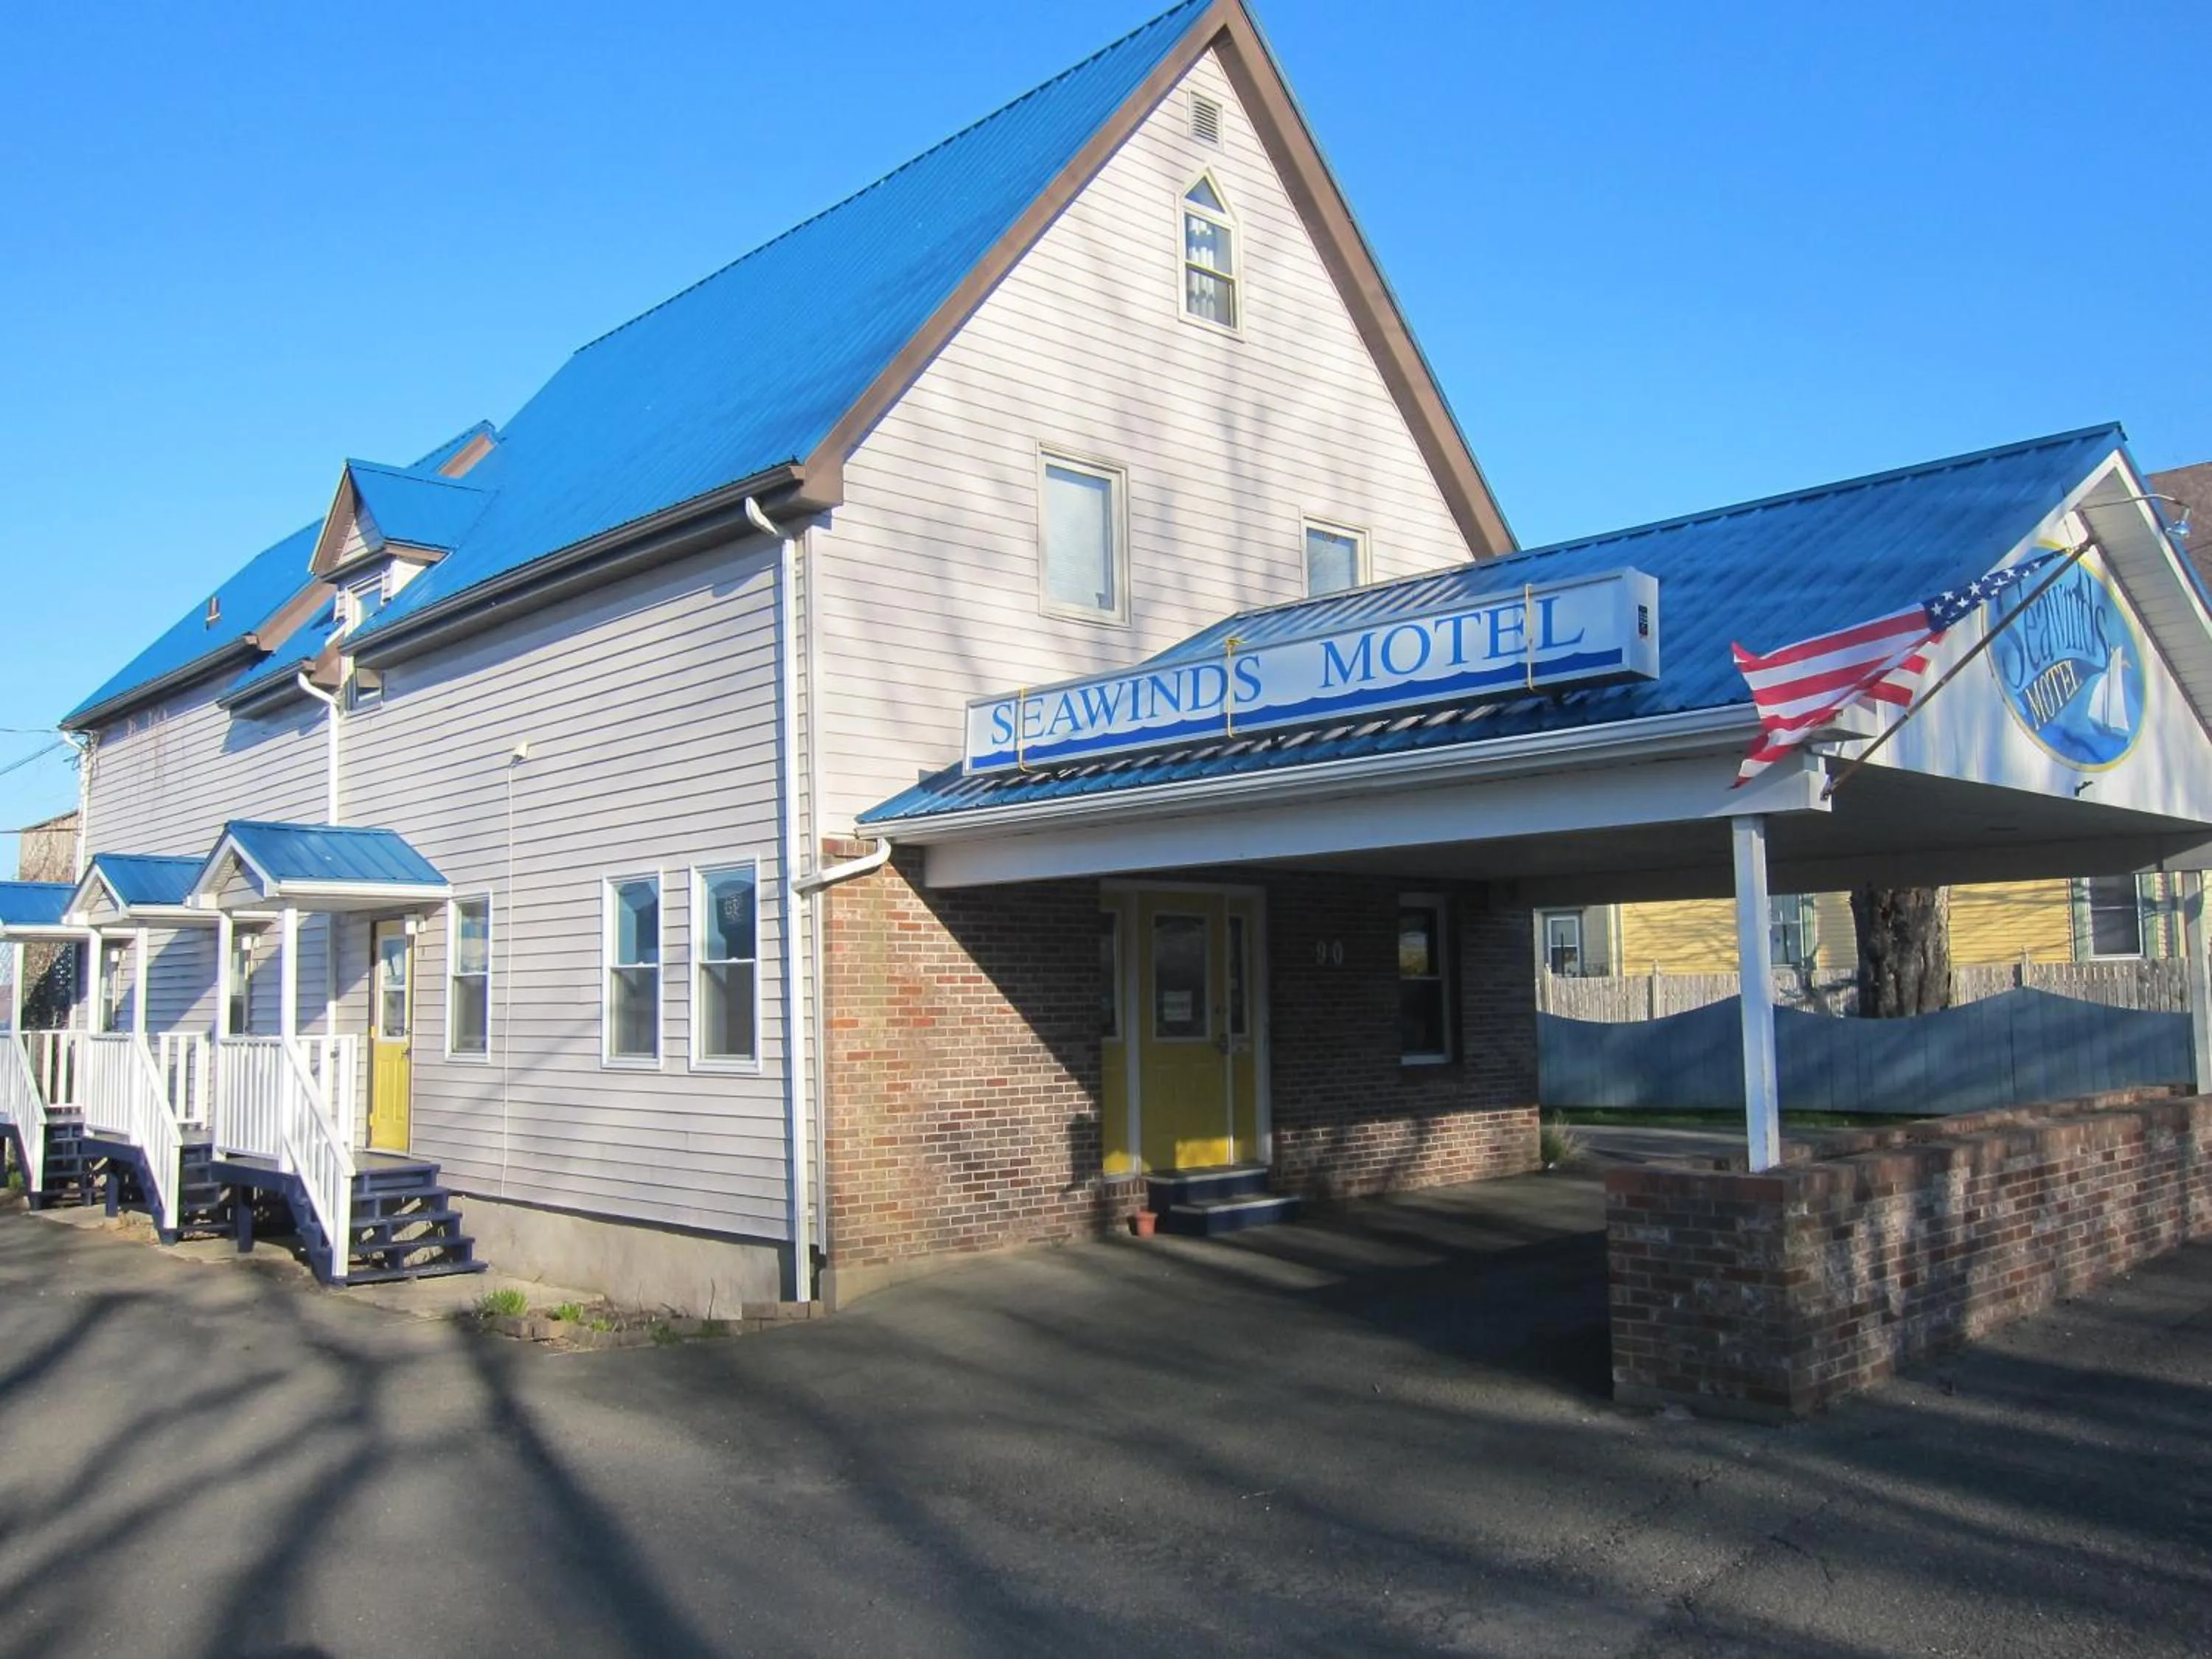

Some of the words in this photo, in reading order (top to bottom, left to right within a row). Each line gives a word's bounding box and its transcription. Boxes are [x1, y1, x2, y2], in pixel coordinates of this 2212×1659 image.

[991, 655, 1262, 745] SEAWINDS
[1317, 595, 1586, 689] MOTEL
[2025, 660, 2084, 731] MOTEL
[1315, 939, 1343, 966] 90
